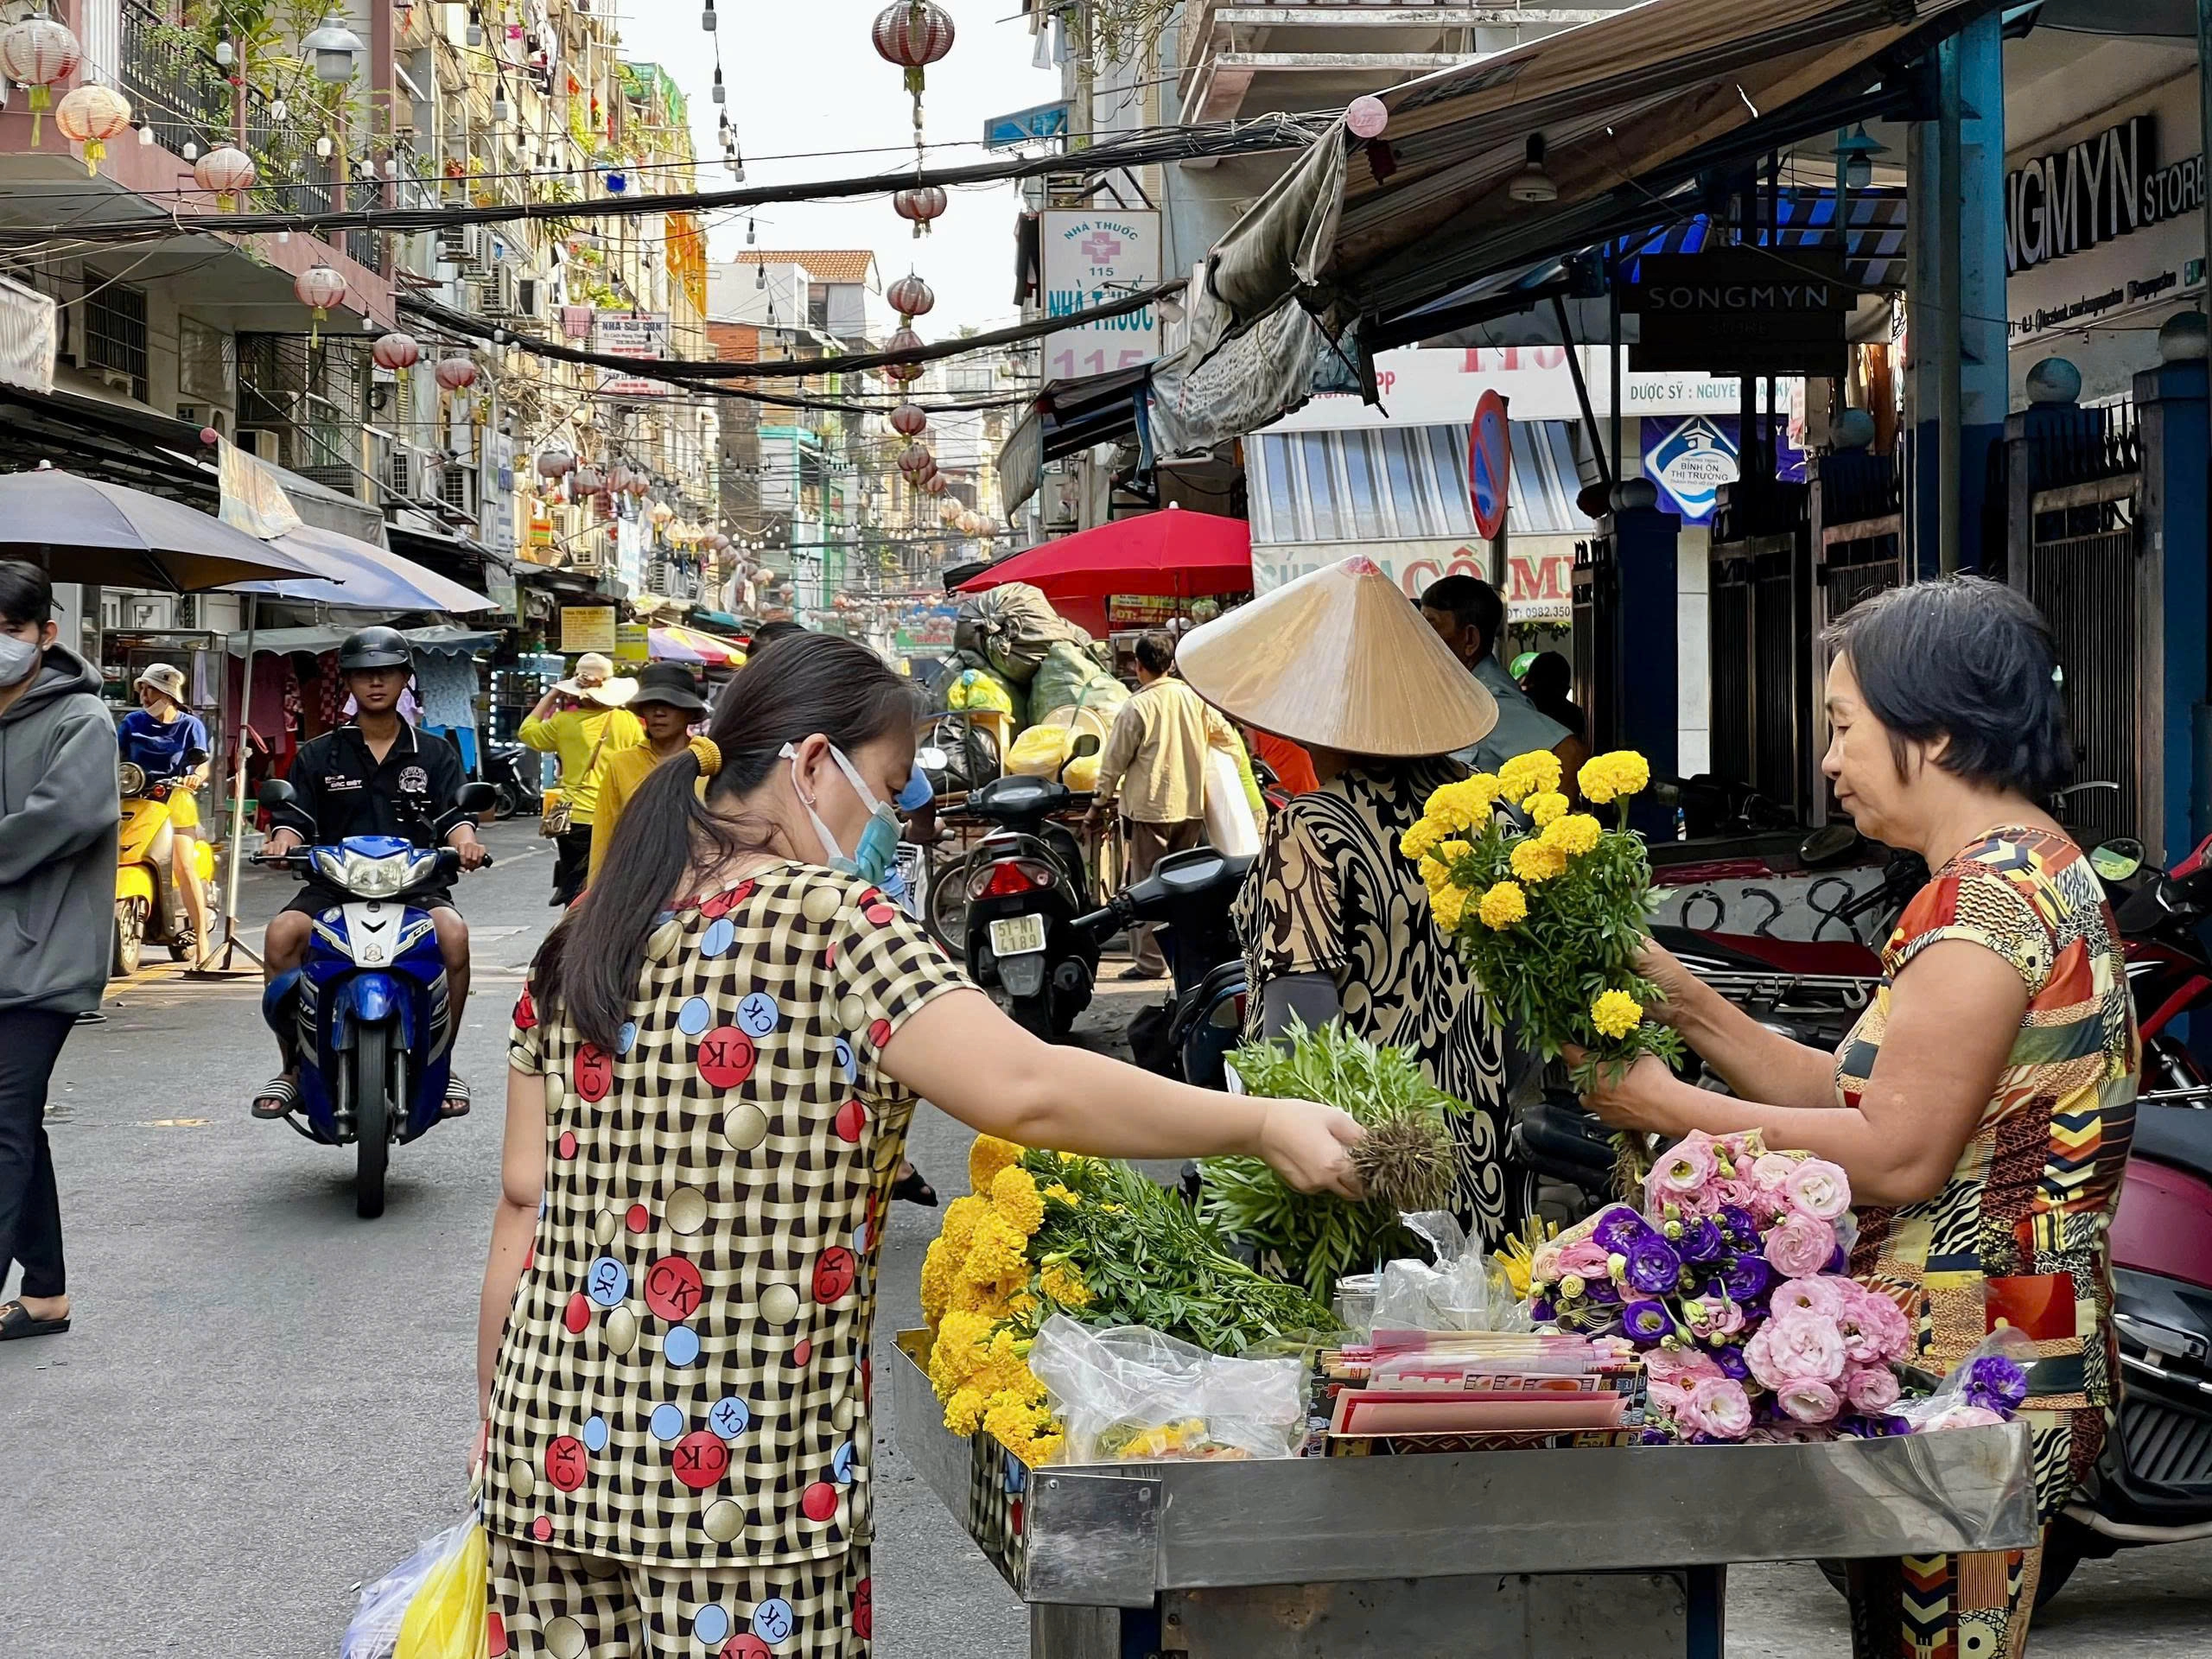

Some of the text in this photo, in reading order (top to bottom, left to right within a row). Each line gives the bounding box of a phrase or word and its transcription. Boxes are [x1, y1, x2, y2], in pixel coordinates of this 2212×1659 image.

[2144, 153, 2204, 222] STORE
[1064, 221, 1139, 241] NHÀ THUỐC
[1089, 267, 1114, 276] 115
[1048, 279, 1085, 330] NHÀ
[1649, 286, 1828, 309] SONGMYN
[1630, 382, 1664, 403] DƯỢC
[1669, 380, 1684, 399] SỸ
[1696, 380, 1741, 399] NGUYỄ
[1402, 546, 1484, 600] CÔ
[1525, 607, 1571, 618] 0982.350
[998, 918, 1033, 938] 51-N1
[1001, 933, 1038, 951] 4189
[742, 997, 772, 1033] CK
[583, 1046, 603, 1096] CK
[701, 1040, 752, 1069] CK
[594, 1261, 619, 1299] CK
[821, 1250, 845, 1297] CK
[649, 1266, 702, 1316] CK
[715, 1402, 744, 1434] CK
[556, 1442, 577, 1487] CK
[677, 1445, 725, 1471] CK
[759, 1603, 788, 1638] CK
